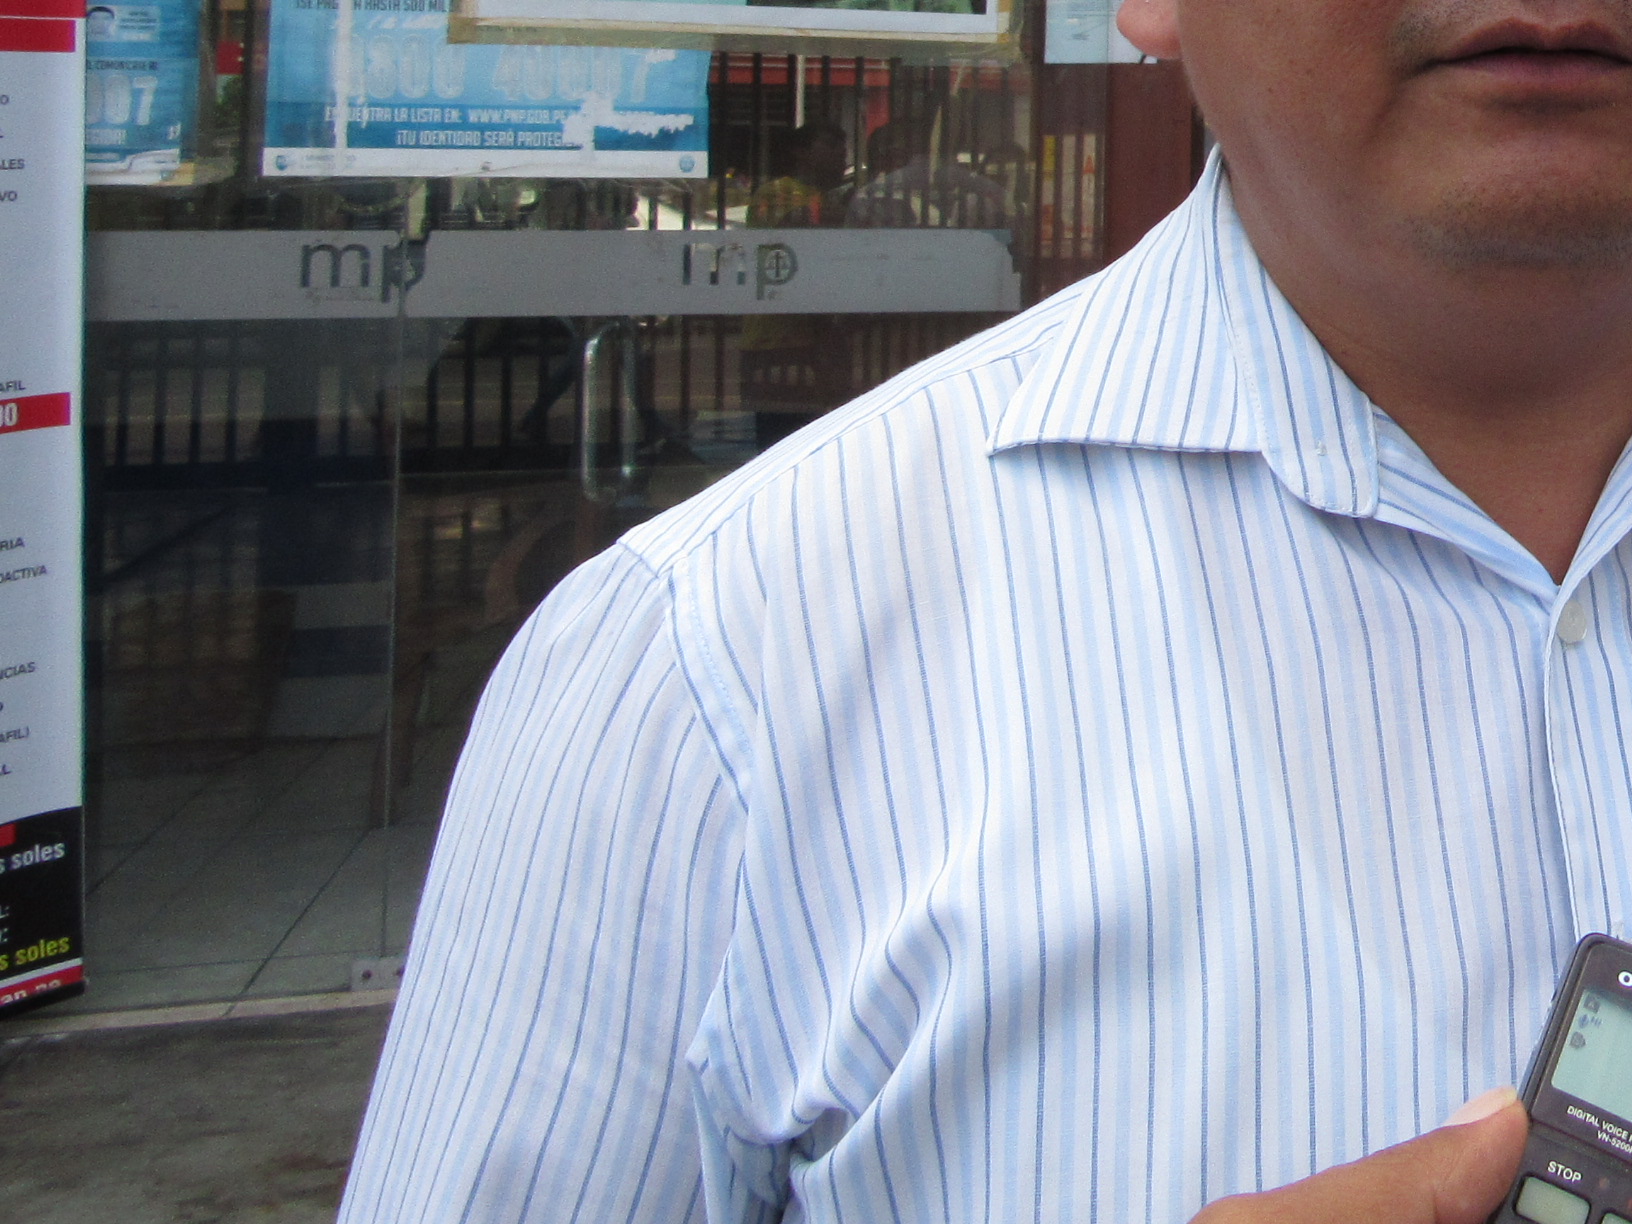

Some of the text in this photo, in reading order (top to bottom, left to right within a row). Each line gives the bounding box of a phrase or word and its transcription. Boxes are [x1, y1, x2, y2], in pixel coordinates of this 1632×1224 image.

[411, 107, 441, 122] LISTA
[419, 130, 481, 146] IDENTIDAD
[484, 128, 515, 146] SERÁ
[11, 841, 65, 870] soles
[15, 936, 71, 966] soles
[1567, 1105, 1599, 1127] DIGITAL
[1602, 1120, 1628, 1139] VOICE
[1547, 1160, 1582, 1183] STOP
